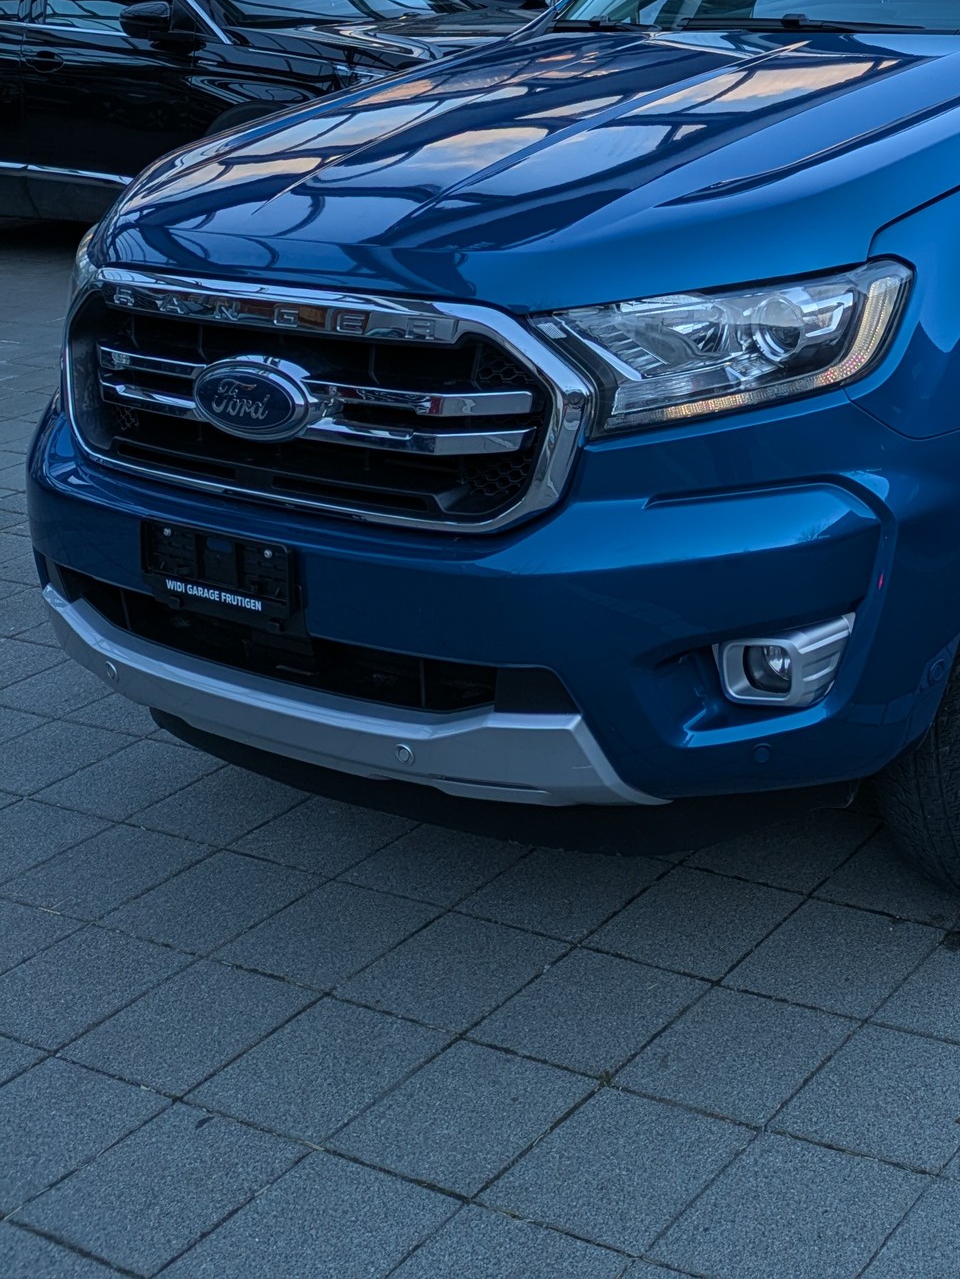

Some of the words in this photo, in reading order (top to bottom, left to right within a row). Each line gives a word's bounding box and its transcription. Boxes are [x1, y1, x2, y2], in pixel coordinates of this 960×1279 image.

[113, 286, 438, 341] RANGER
[211, 378, 271, 420] Ford
[165, 579, 185, 593] WIDI
[186, 584, 220, 601] GARAGE
[221, 592, 262, 611] FRUTIGEN
